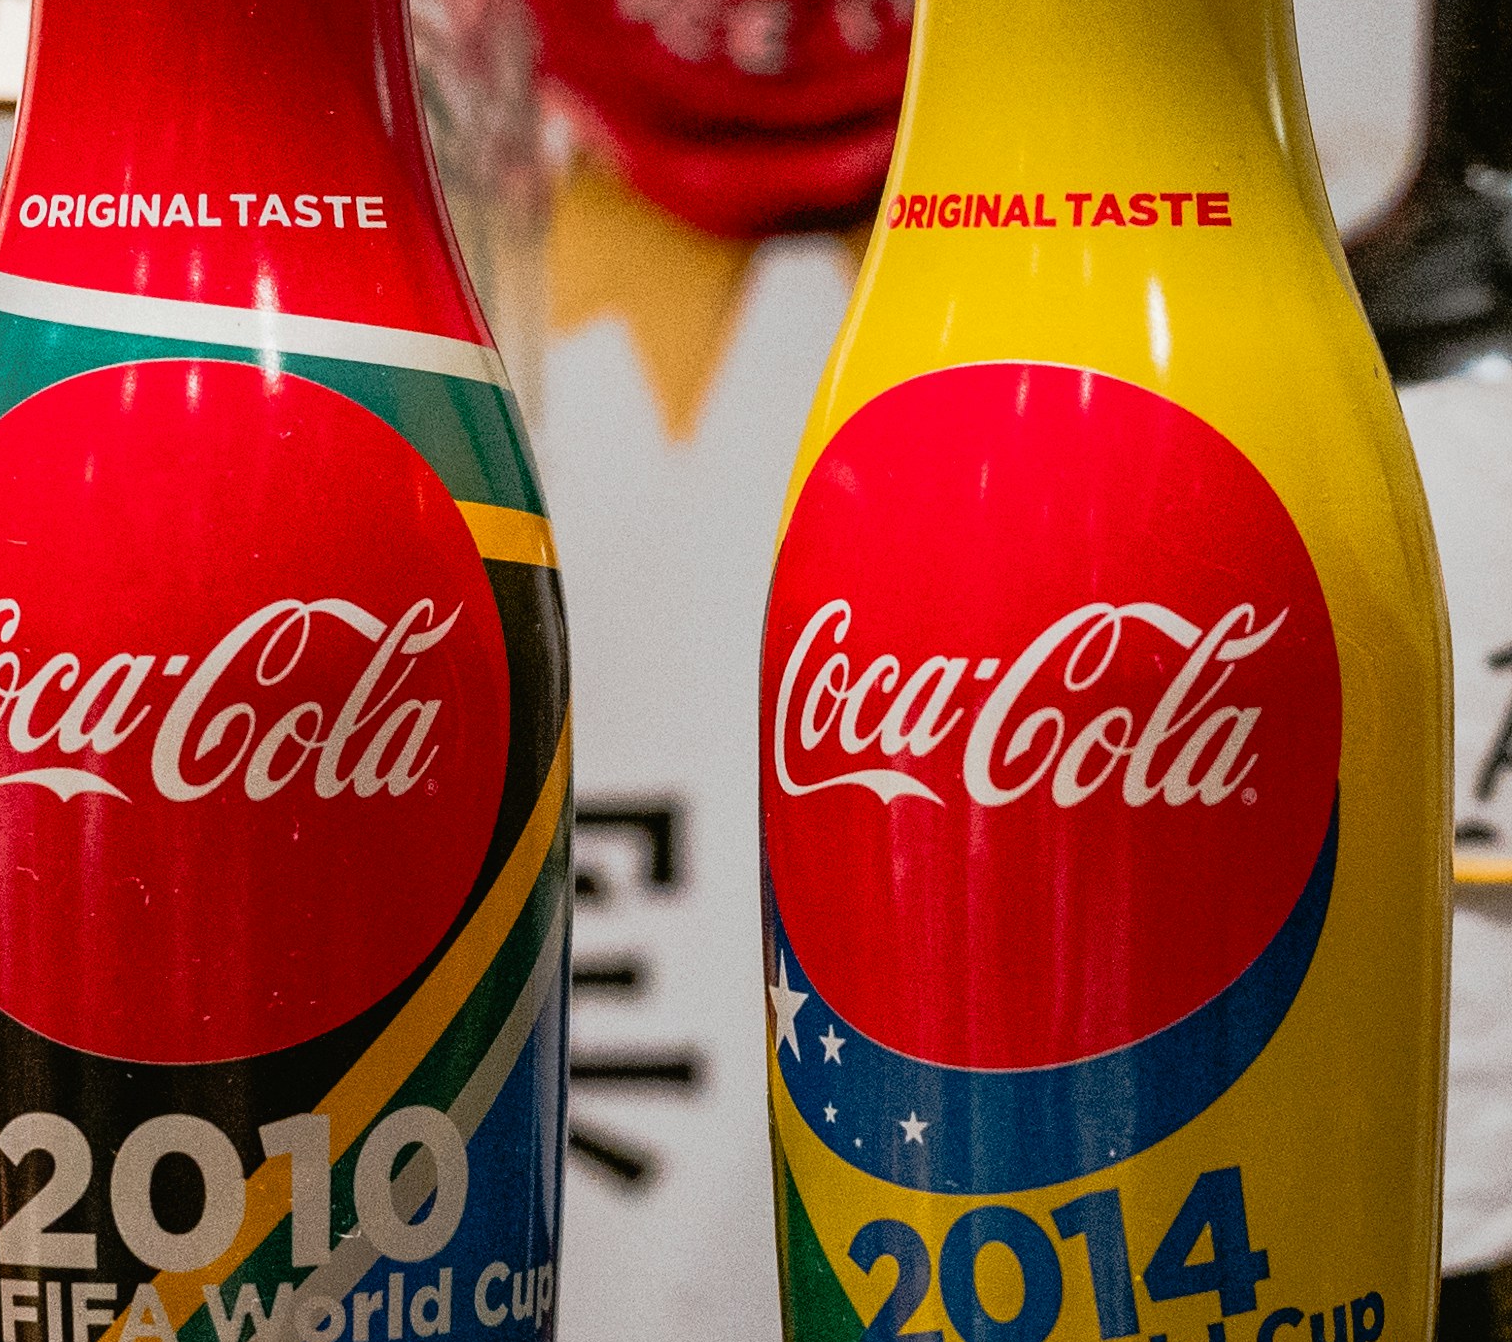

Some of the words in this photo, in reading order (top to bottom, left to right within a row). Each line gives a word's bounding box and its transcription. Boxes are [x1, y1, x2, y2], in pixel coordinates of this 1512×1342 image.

[17, 193, 222, 229] ORIGINAL
[229, 193, 389, 230] TASTE
[888, 192, 1057, 230] ORIGINAL
[1064, 191, 1233, 229] TASTE
[774, 598, 1290, 809] Coca-Cola
[474, 1260, 555, 1330] Cup
